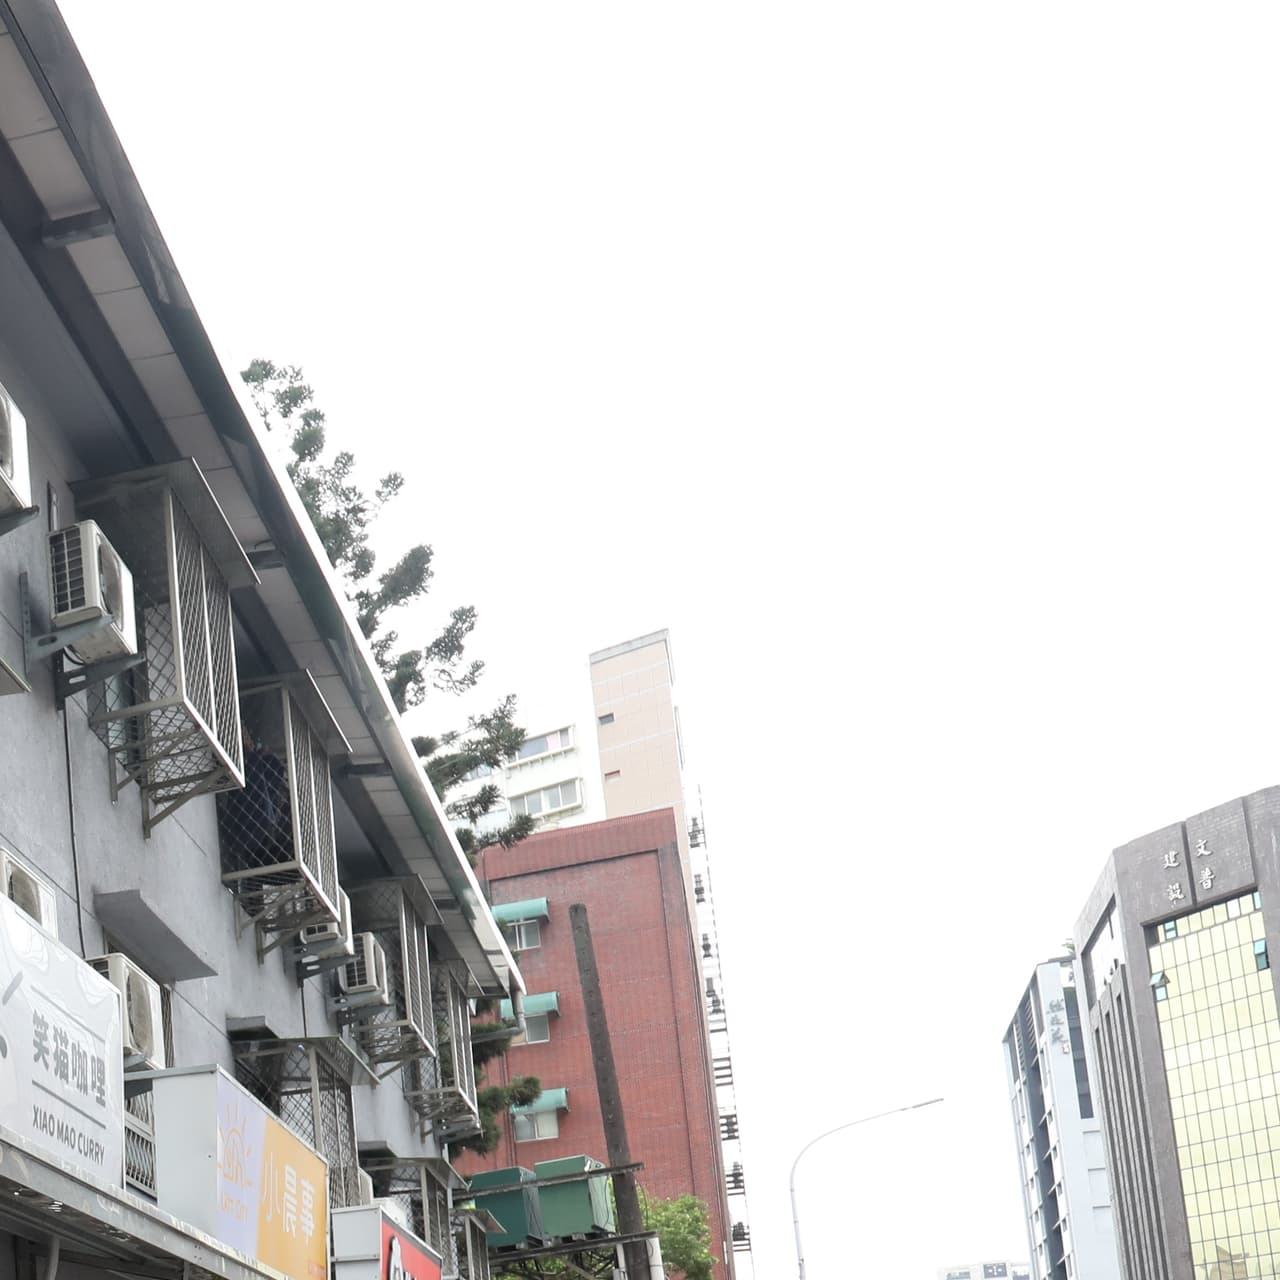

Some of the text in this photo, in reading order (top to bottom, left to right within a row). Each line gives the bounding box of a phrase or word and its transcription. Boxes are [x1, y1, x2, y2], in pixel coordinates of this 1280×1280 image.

[32, 1108, 106, 1168] XIAO MAO CURRY
